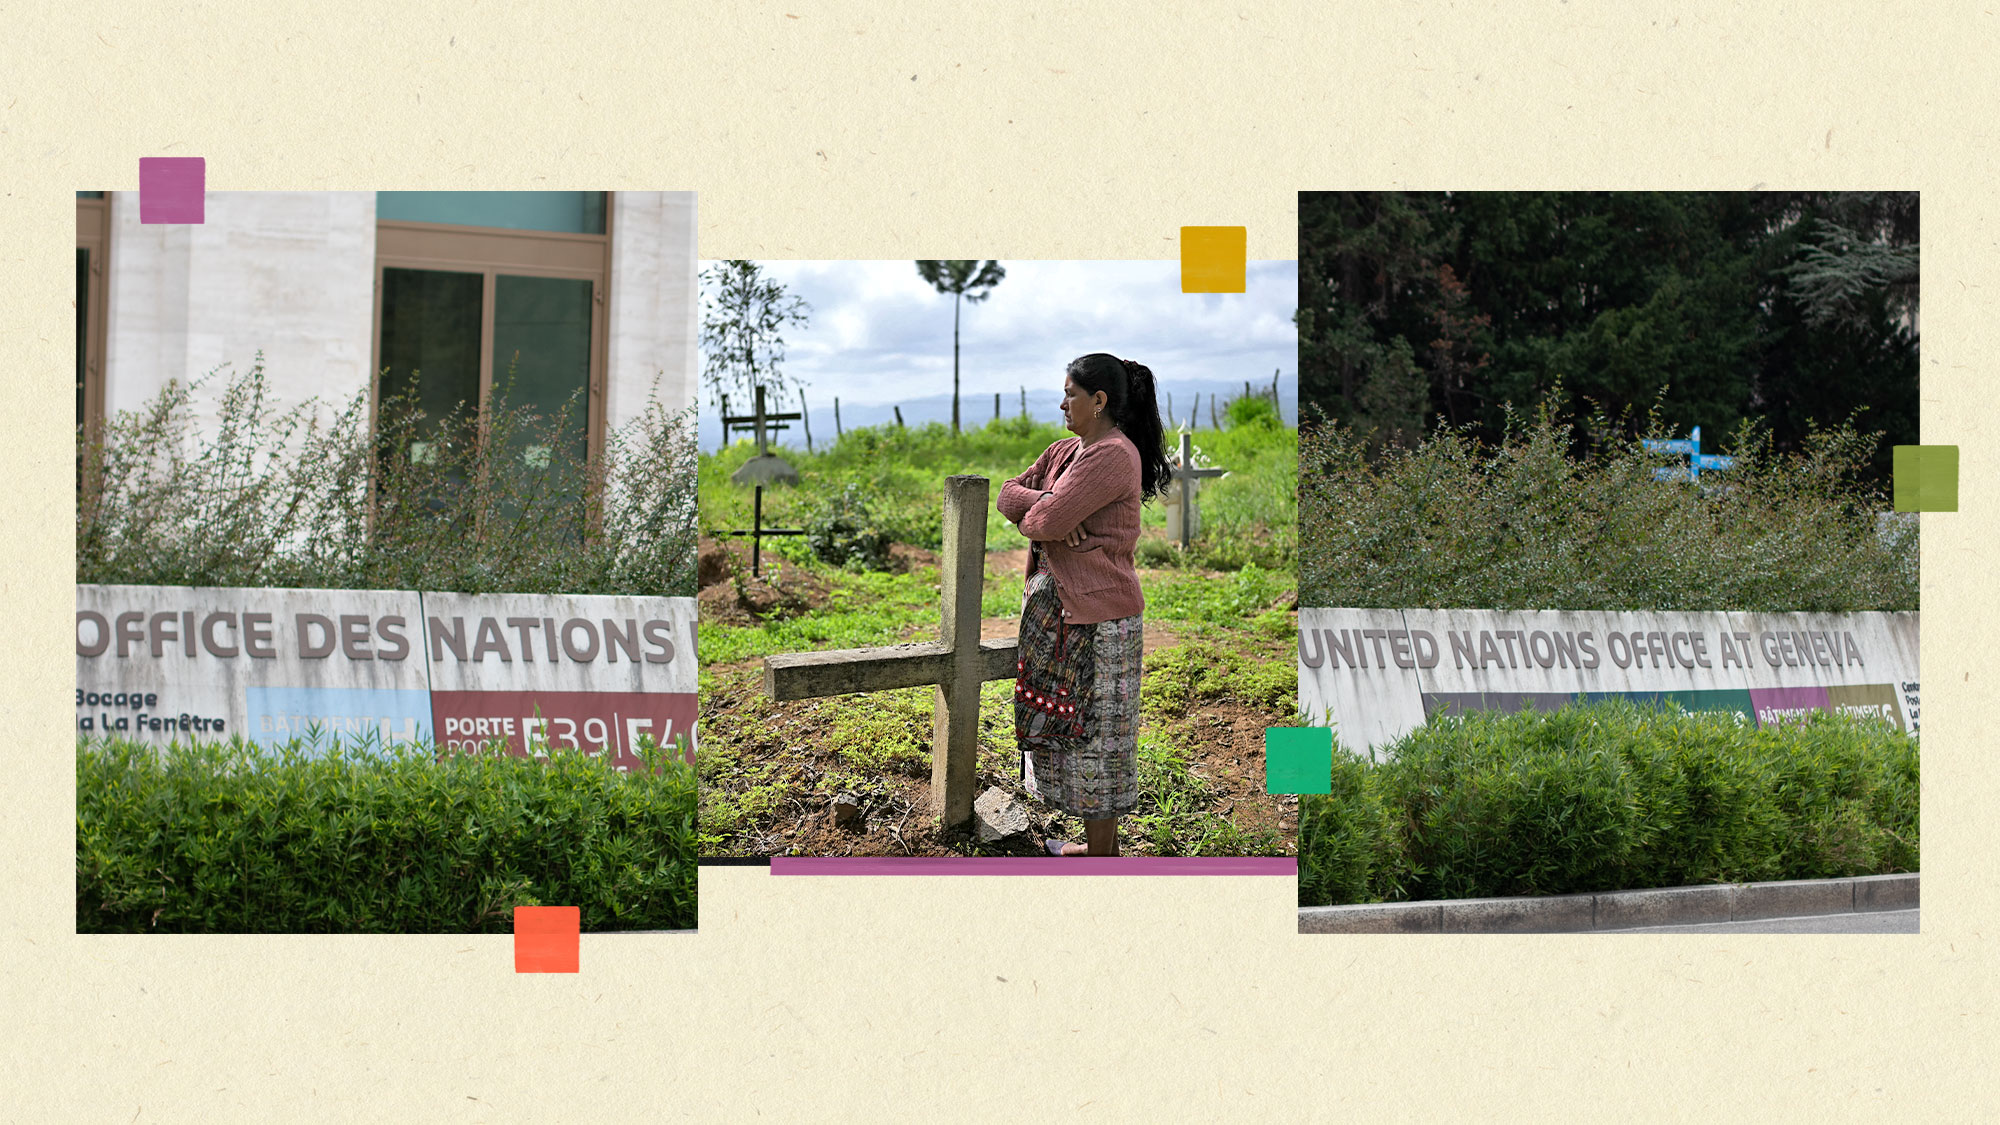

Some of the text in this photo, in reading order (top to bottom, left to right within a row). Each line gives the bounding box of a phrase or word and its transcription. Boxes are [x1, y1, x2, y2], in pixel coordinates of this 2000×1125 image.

[76, 611, 276, 658] OFFICE
[296, 613, 410, 661] DES
[428, 616, 675, 663] NATIONS
[1298, 629, 1864, 669] UNITED NATIONS OFFICE AT GENEVA
[76, 688, 158, 709] Bocage
[102, 713, 129, 732] La
[137, 713, 225, 732] Fenêtre
[260, 710, 373, 733] BÂTIMENT
[380, 717, 414, 756] H
[445, 717, 516, 736] PORTE
